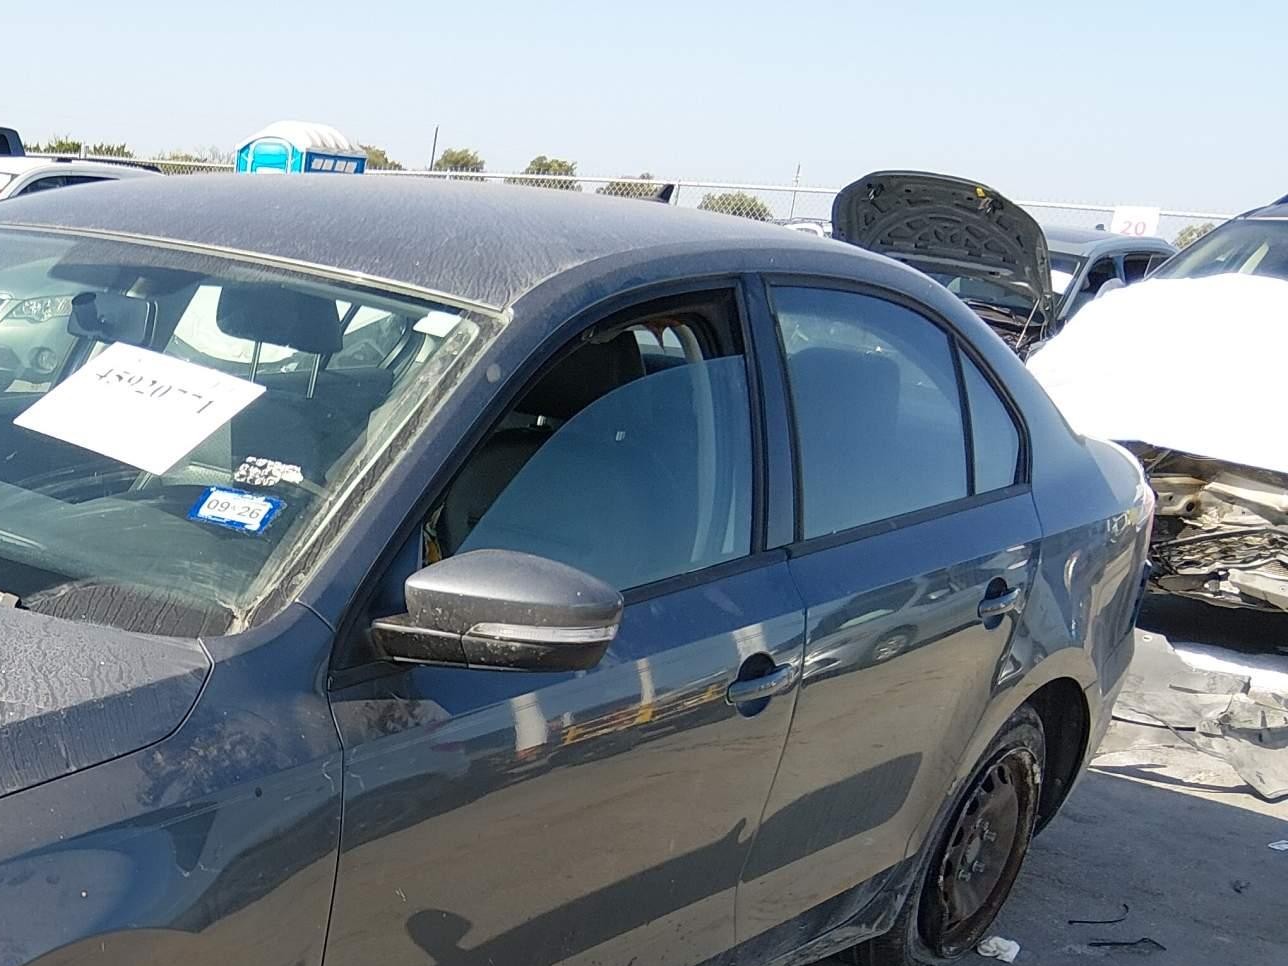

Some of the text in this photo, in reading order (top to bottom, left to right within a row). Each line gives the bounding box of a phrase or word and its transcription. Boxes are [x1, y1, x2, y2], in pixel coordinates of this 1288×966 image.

[1120, 220, 1146, 236] 20
[206, 499, 261, 519] 09 26
